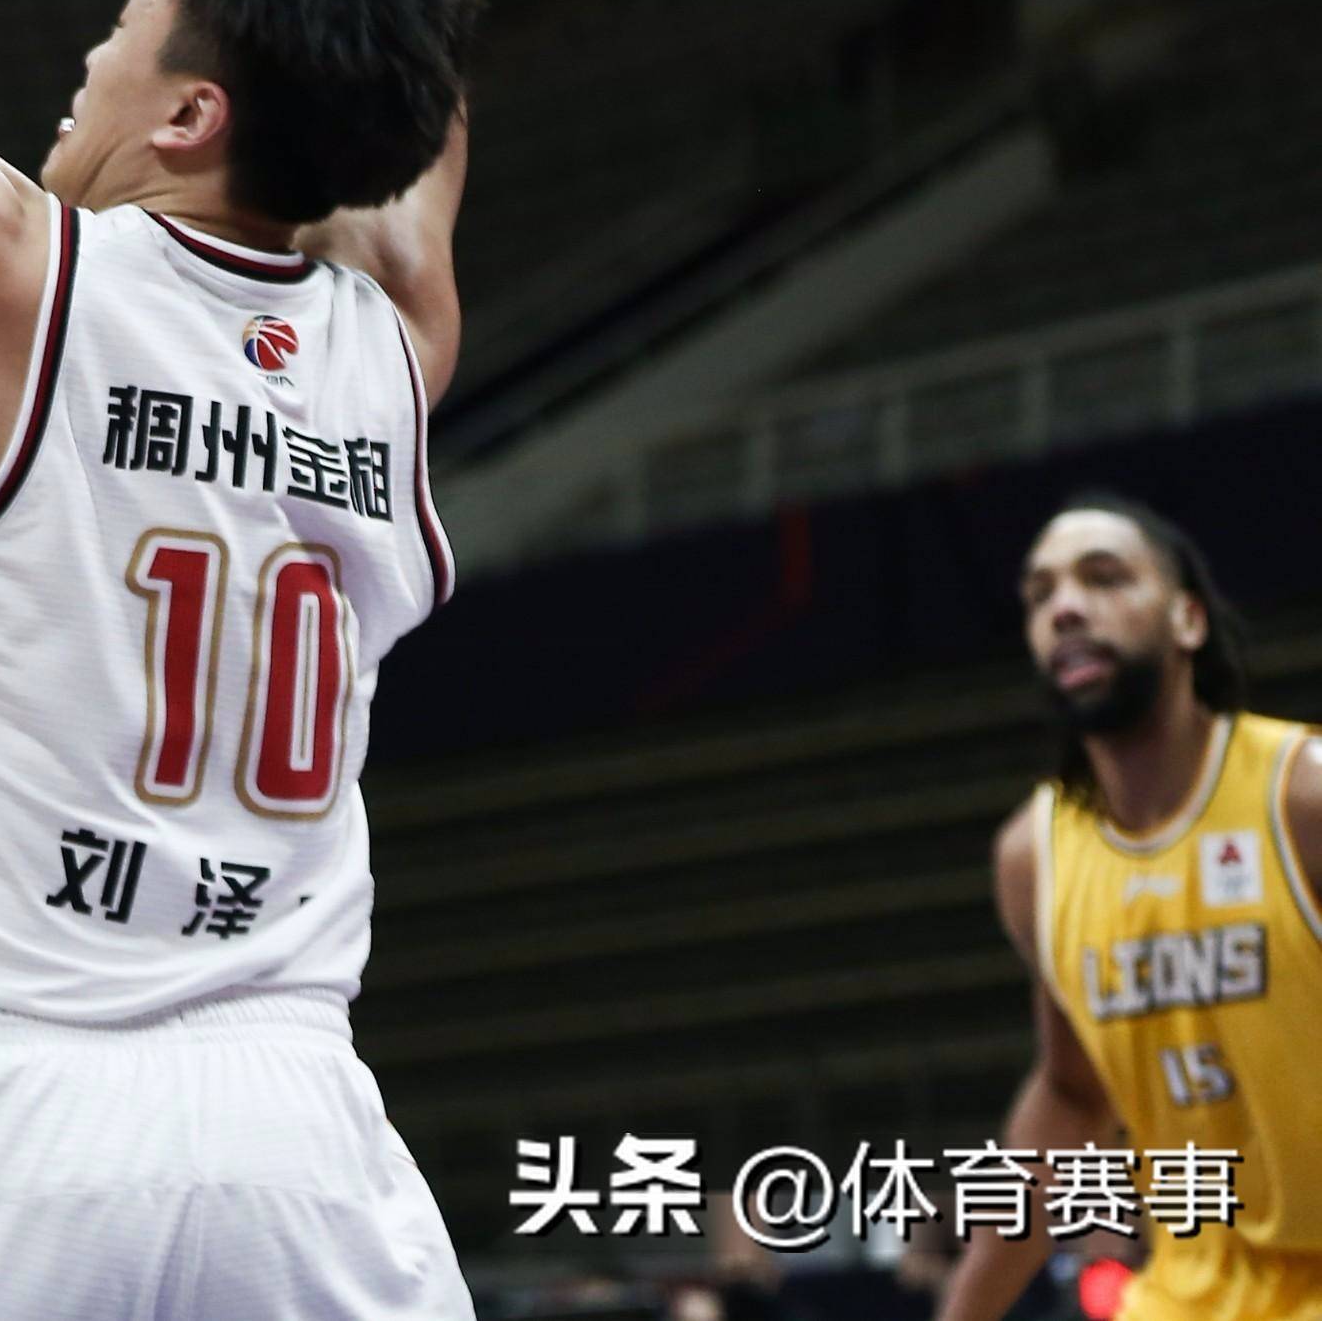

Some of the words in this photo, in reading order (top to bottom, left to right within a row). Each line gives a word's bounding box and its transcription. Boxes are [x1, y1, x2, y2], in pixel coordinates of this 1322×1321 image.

[103, 384, 393, 522] 稠州金租
[125, 527, 353, 822] 10
[46, 828, 314, 941] 刘泽
[1081, 920, 1268, 1021] LIONS
[1160, 1042, 1236, 1109] 15
